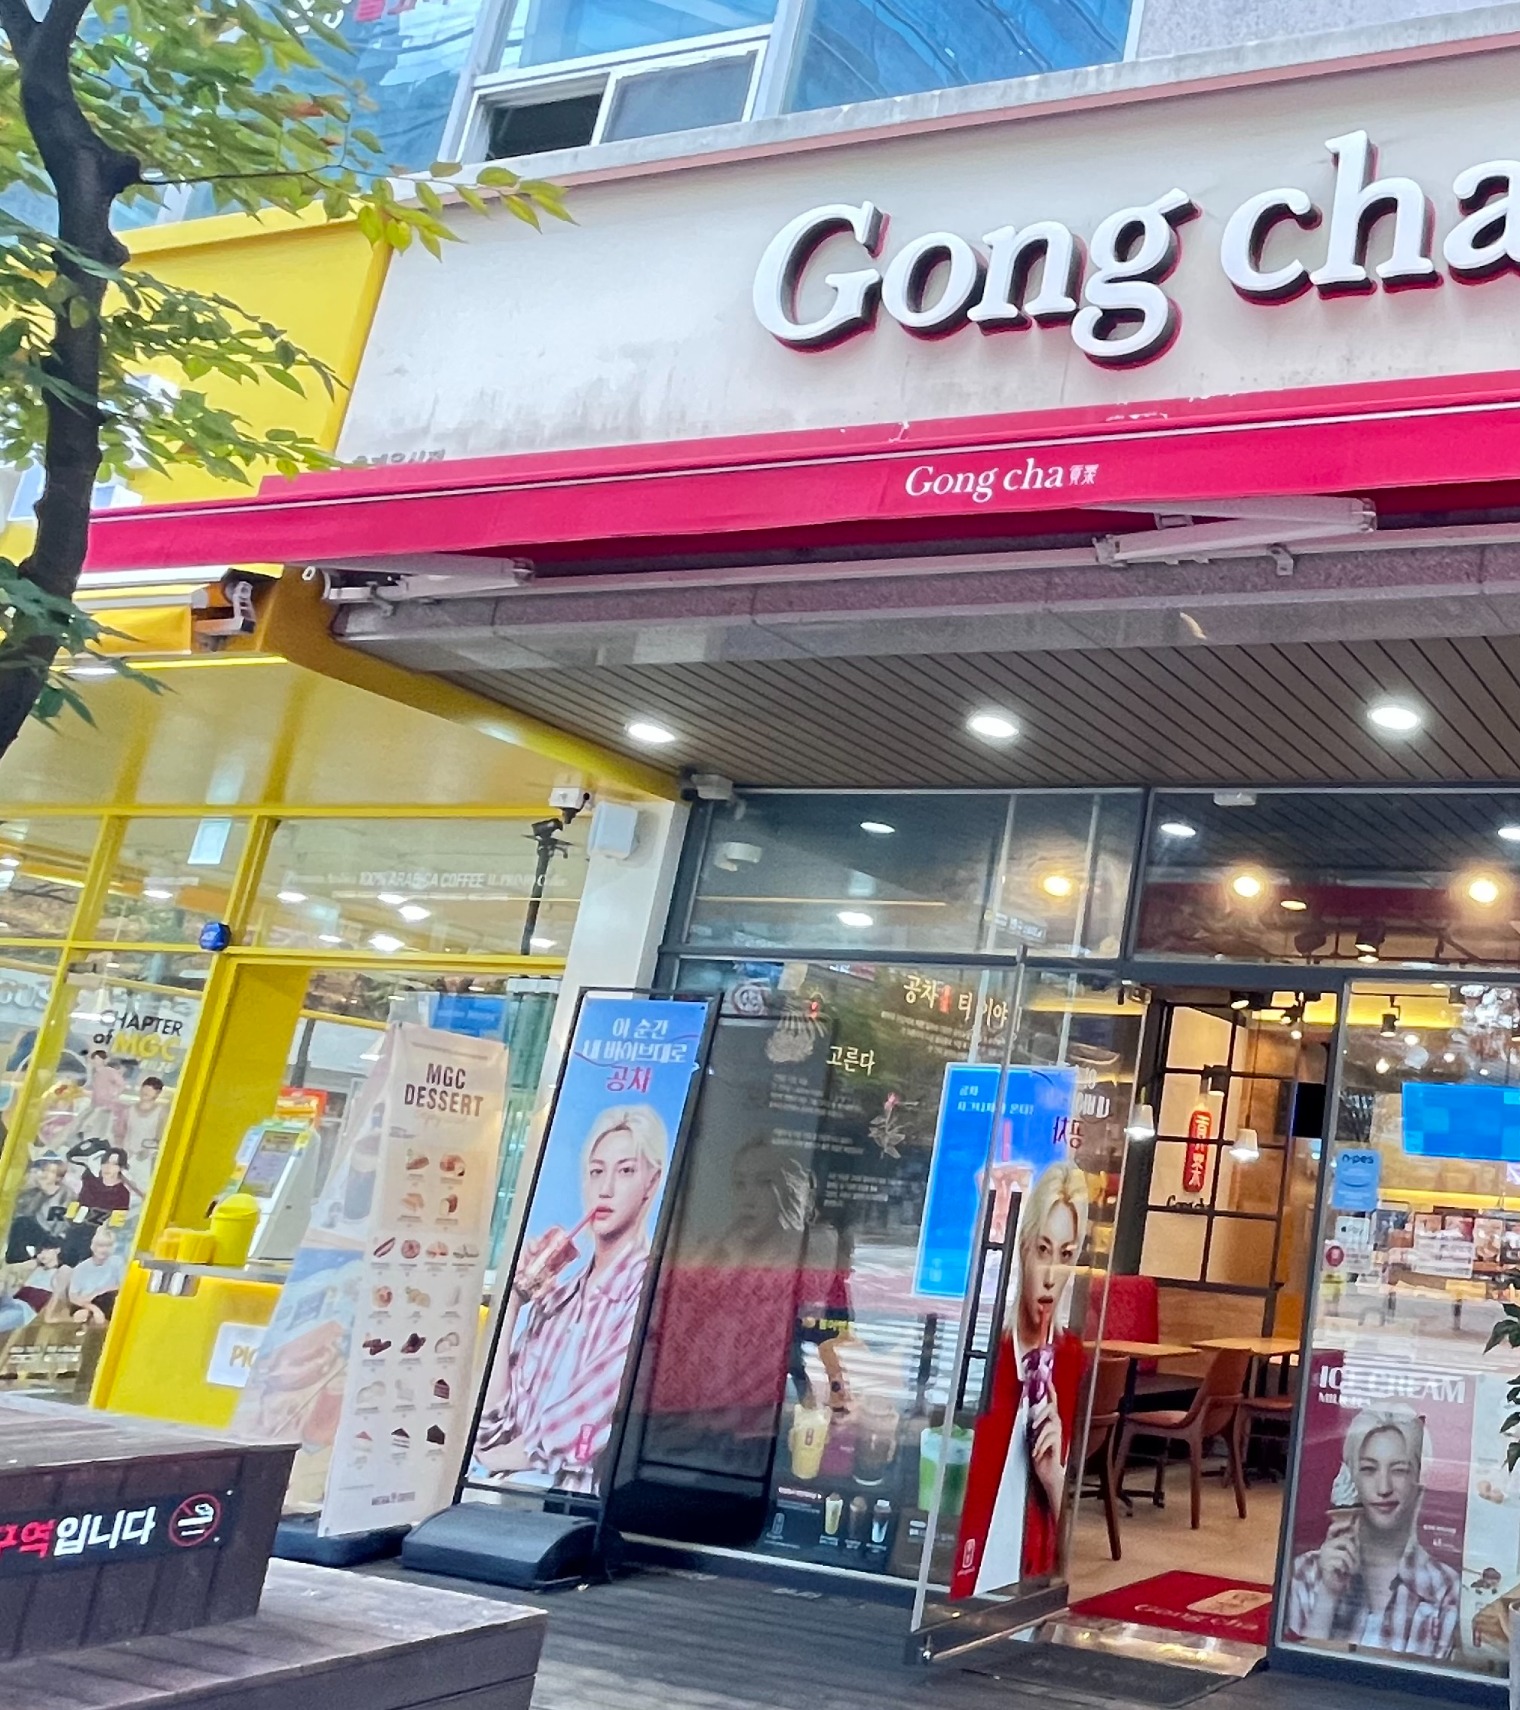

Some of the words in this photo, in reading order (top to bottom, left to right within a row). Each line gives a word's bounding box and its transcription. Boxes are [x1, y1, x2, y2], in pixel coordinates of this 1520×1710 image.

[753, 187, 1198, 368] Gong
[905, 465, 999, 503] Gong
[1003, 457, 1063, 491] cha
[440, 873, 484, 888] COFFEE
[903, 974, 938, 1009] 공차
[957, 991, 973, 1022] 티
[982, 997, 1023, 1033] 이야
[100, 1009, 183, 1036] CHAPTER
[612, 1017, 631, 1039] 이
[633, 1018, 668, 1040] 순간
[93, 1029, 115, 1046] of
[111, 1033, 182, 1062] MGC
[825, 1045, 876, 1076] 고른다
[426, 1062, 466, 1090] MGC
[606, 1066, 652, 1094] 공차
[404, 1083, 484, 1117] DESSERT
[0, 1506, 157, 1559] 구역입니다
